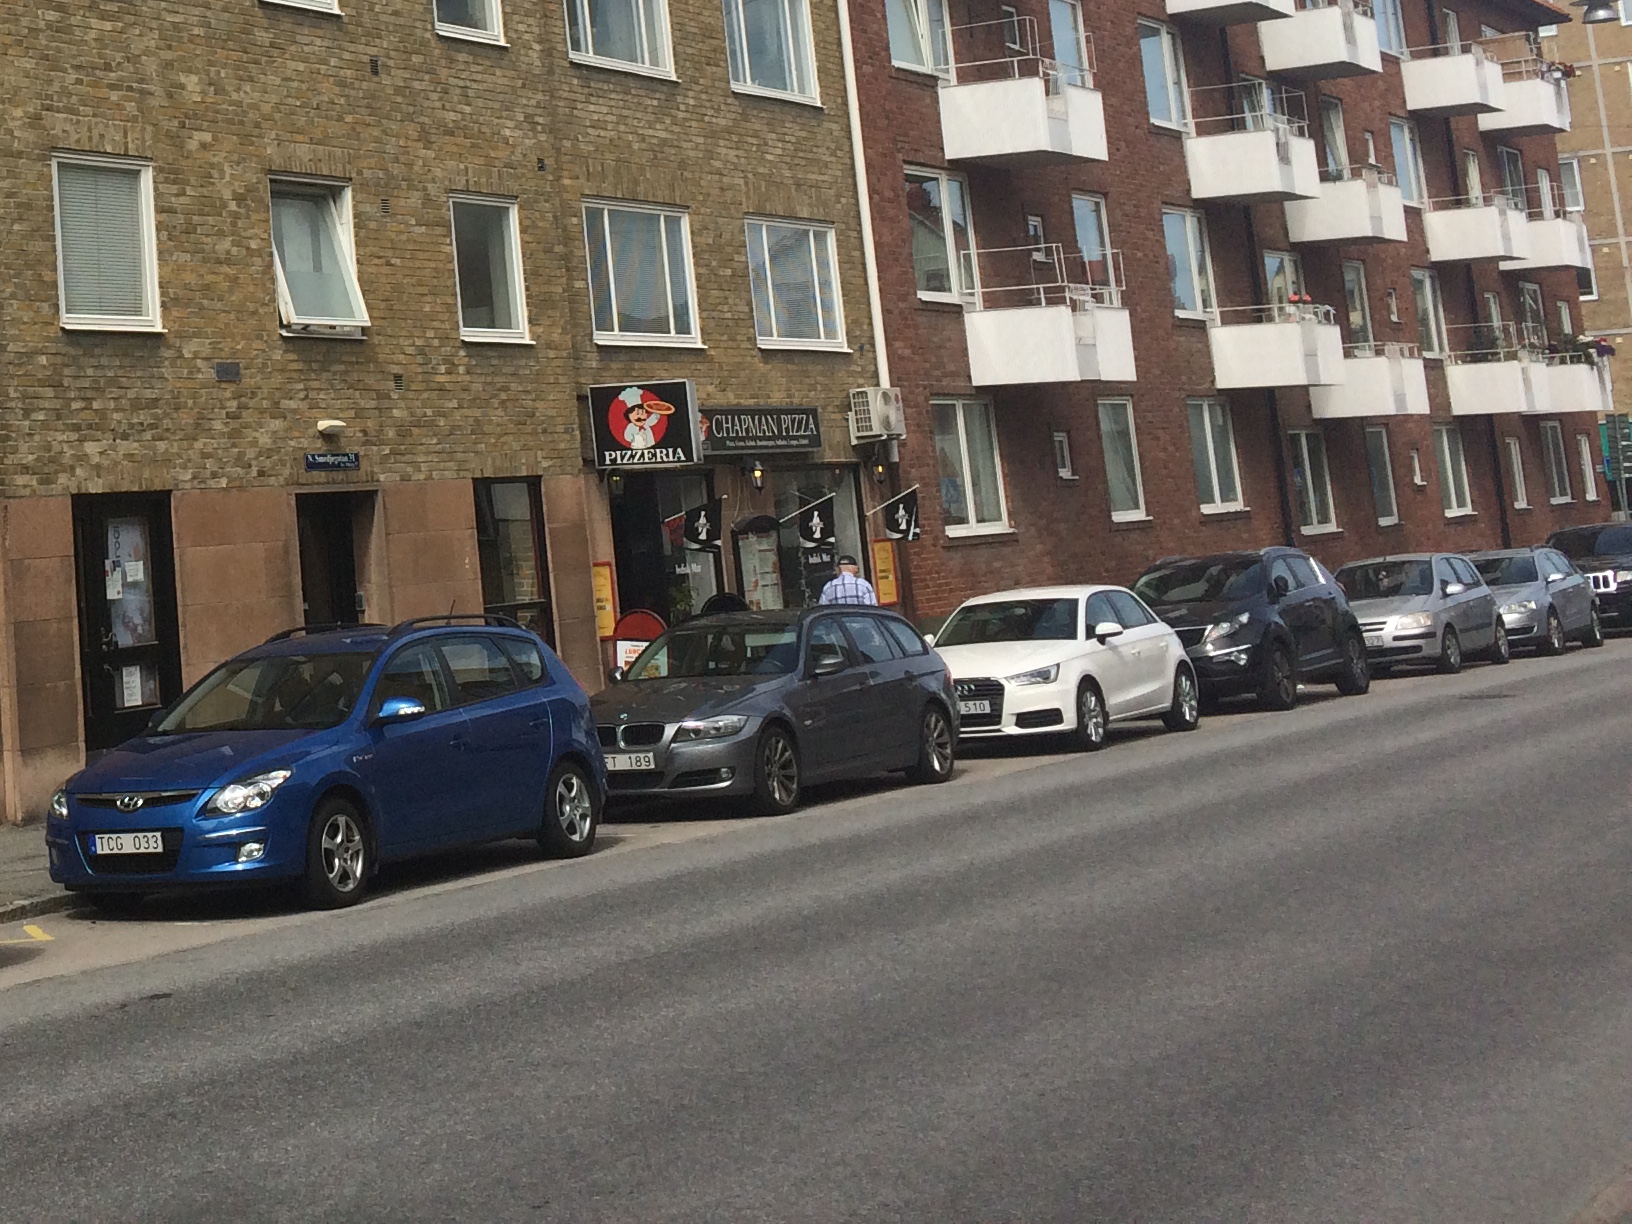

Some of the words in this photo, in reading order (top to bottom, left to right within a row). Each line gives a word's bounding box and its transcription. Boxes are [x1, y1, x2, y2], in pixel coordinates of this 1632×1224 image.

[712, 415, 778, 437] CHAPMAN
[781, 414, 817, 436] PIZZA
[604, 447, 686, 464] PIZZERIA
[964, 702, 986, 713] 510
[628, 755, 651, 768] 189
[98, 836, 124, 852] TCG
[133, 834, 159, 850] 033
